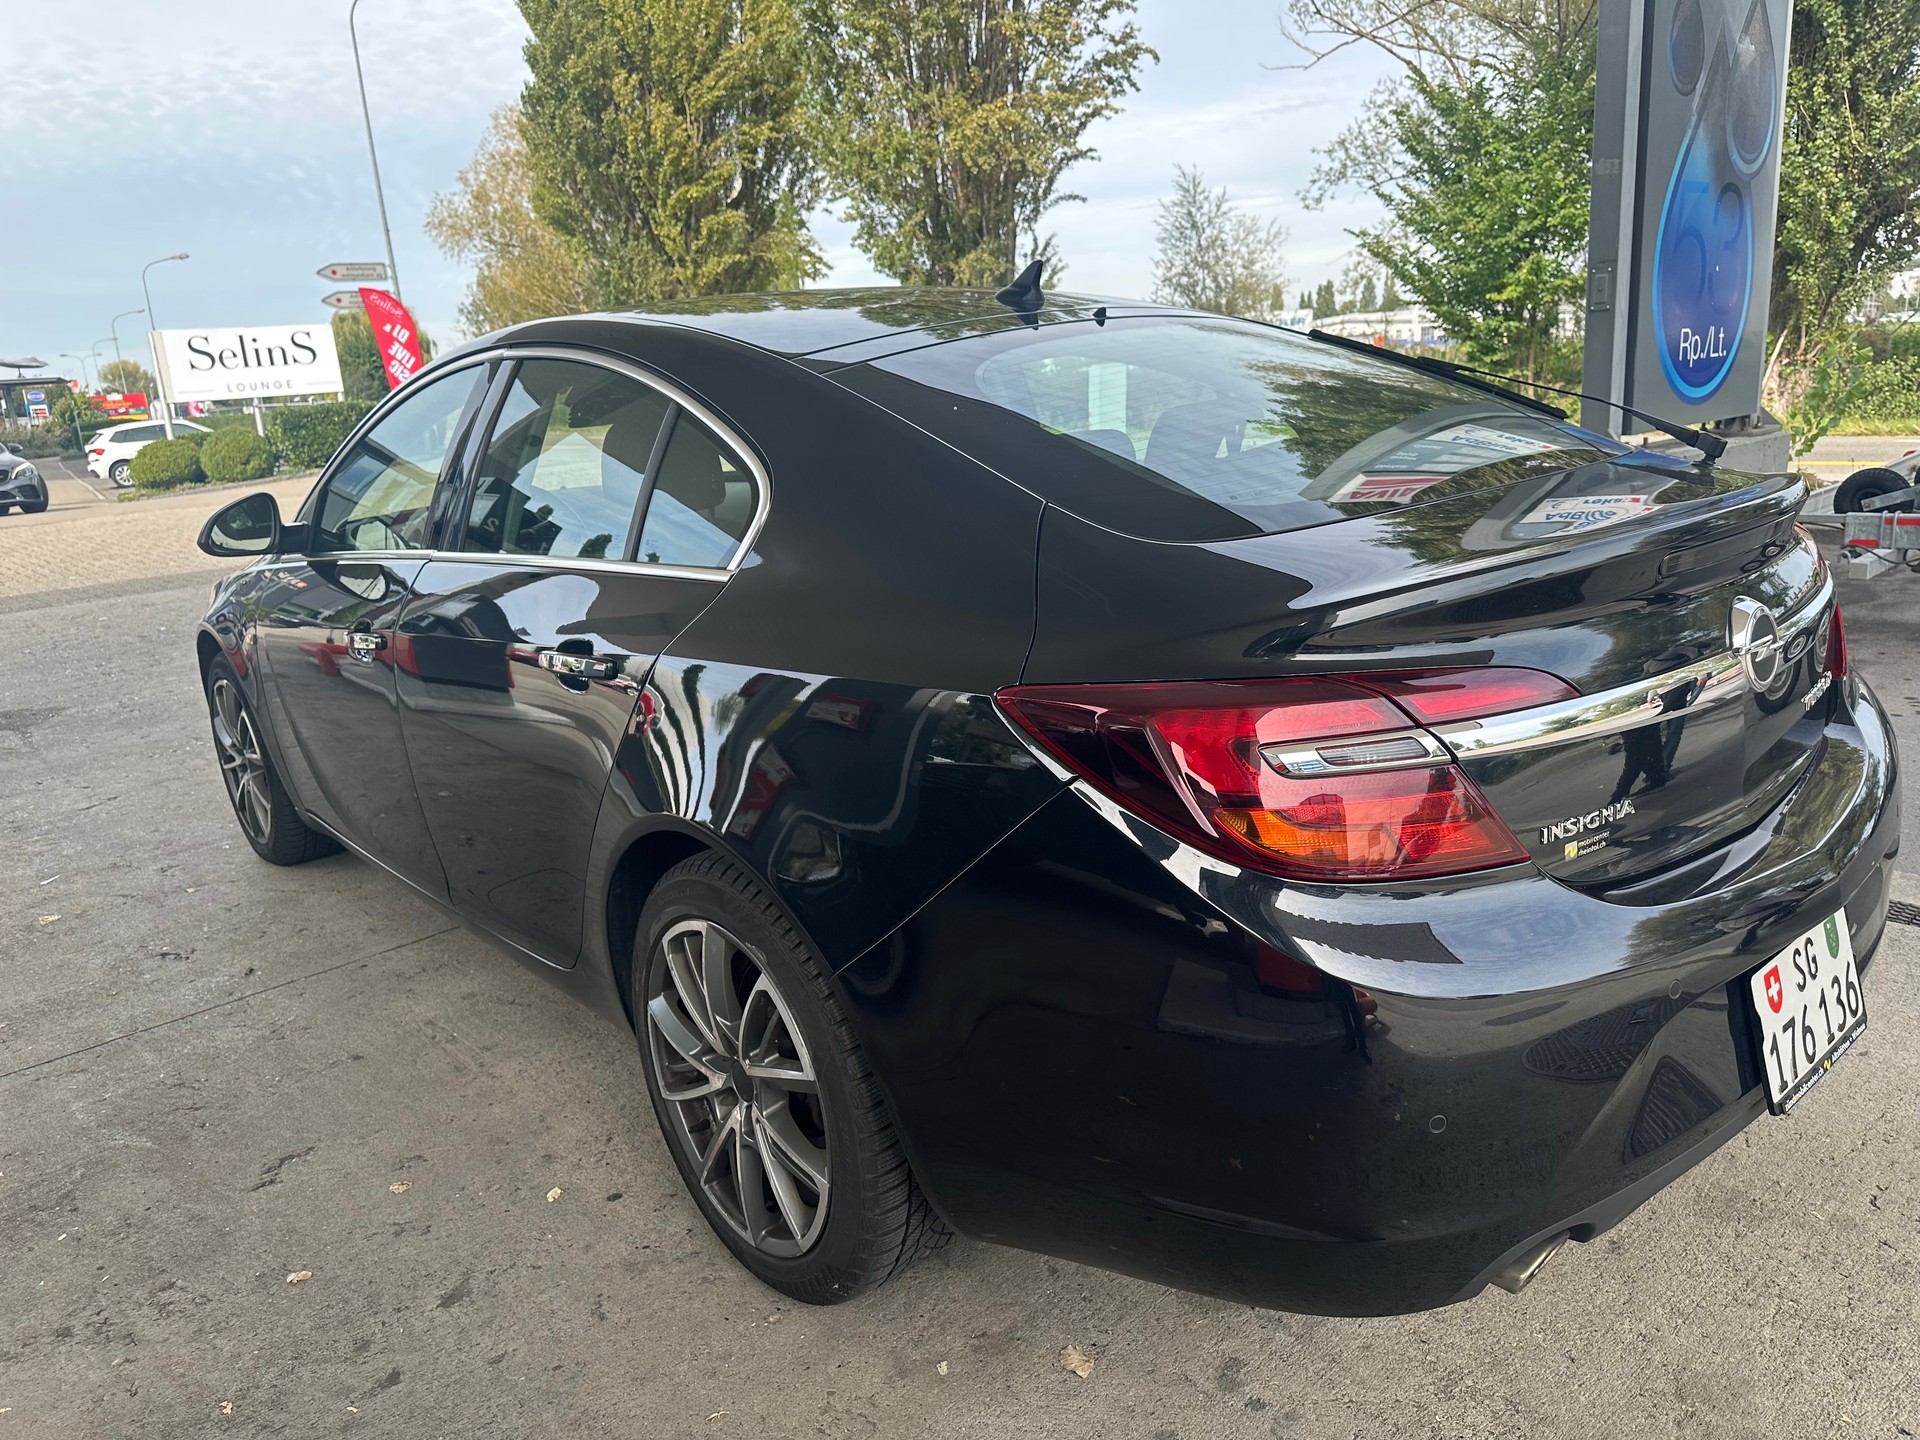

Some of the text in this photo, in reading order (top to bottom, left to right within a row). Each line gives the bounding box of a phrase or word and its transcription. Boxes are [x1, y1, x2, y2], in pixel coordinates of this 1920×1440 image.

[187, 330, 317, 371] SelinS
[1679, 325, 1727, 368] Rp./Lt.
[226, 379, 293, 393] LOUNGE
[1540, 798, 1635, 845] INSIGNIA
[1793, 936, 1819, 992] SG
[1769, 960, 1859, 1095] 176 136
